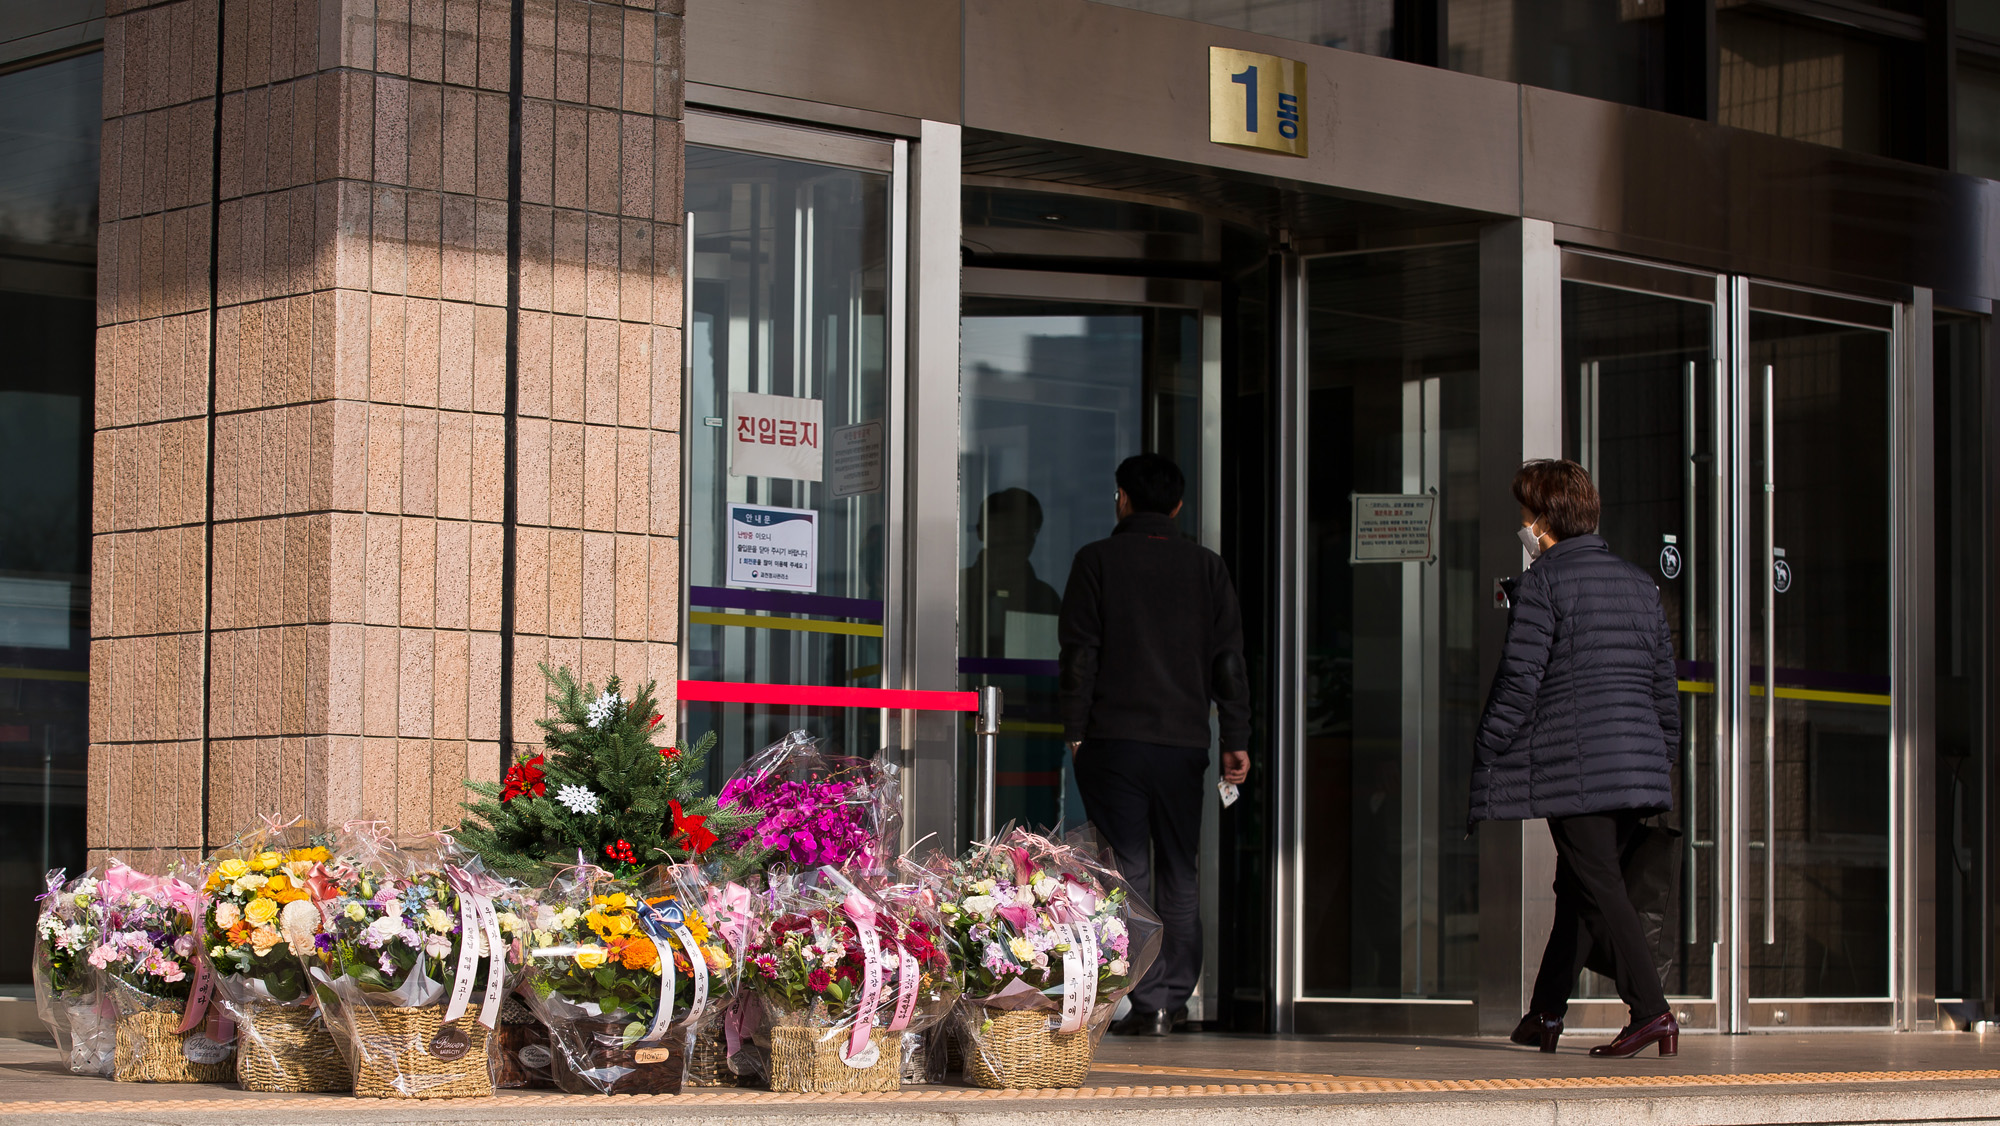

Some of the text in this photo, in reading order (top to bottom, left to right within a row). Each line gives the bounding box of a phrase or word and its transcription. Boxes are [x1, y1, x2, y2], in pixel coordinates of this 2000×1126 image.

[737, 416, 818, 449] 진입금지
[737, 531, 772, 541] 난방중 이오니
[737, 544, 808, 558] 출입문을 닫아 주시기 바랍니다
[790, 561, 803, 569] 주세요
[485, 906, 500, 1004] 우리가 추미애다
[680, 929, 699, 958] 우리가
[863, 929, 878, 965] 힘내시고
[870, 969, 879, 988] 건강
[1068, 977, 1079, 1016] 추미애
